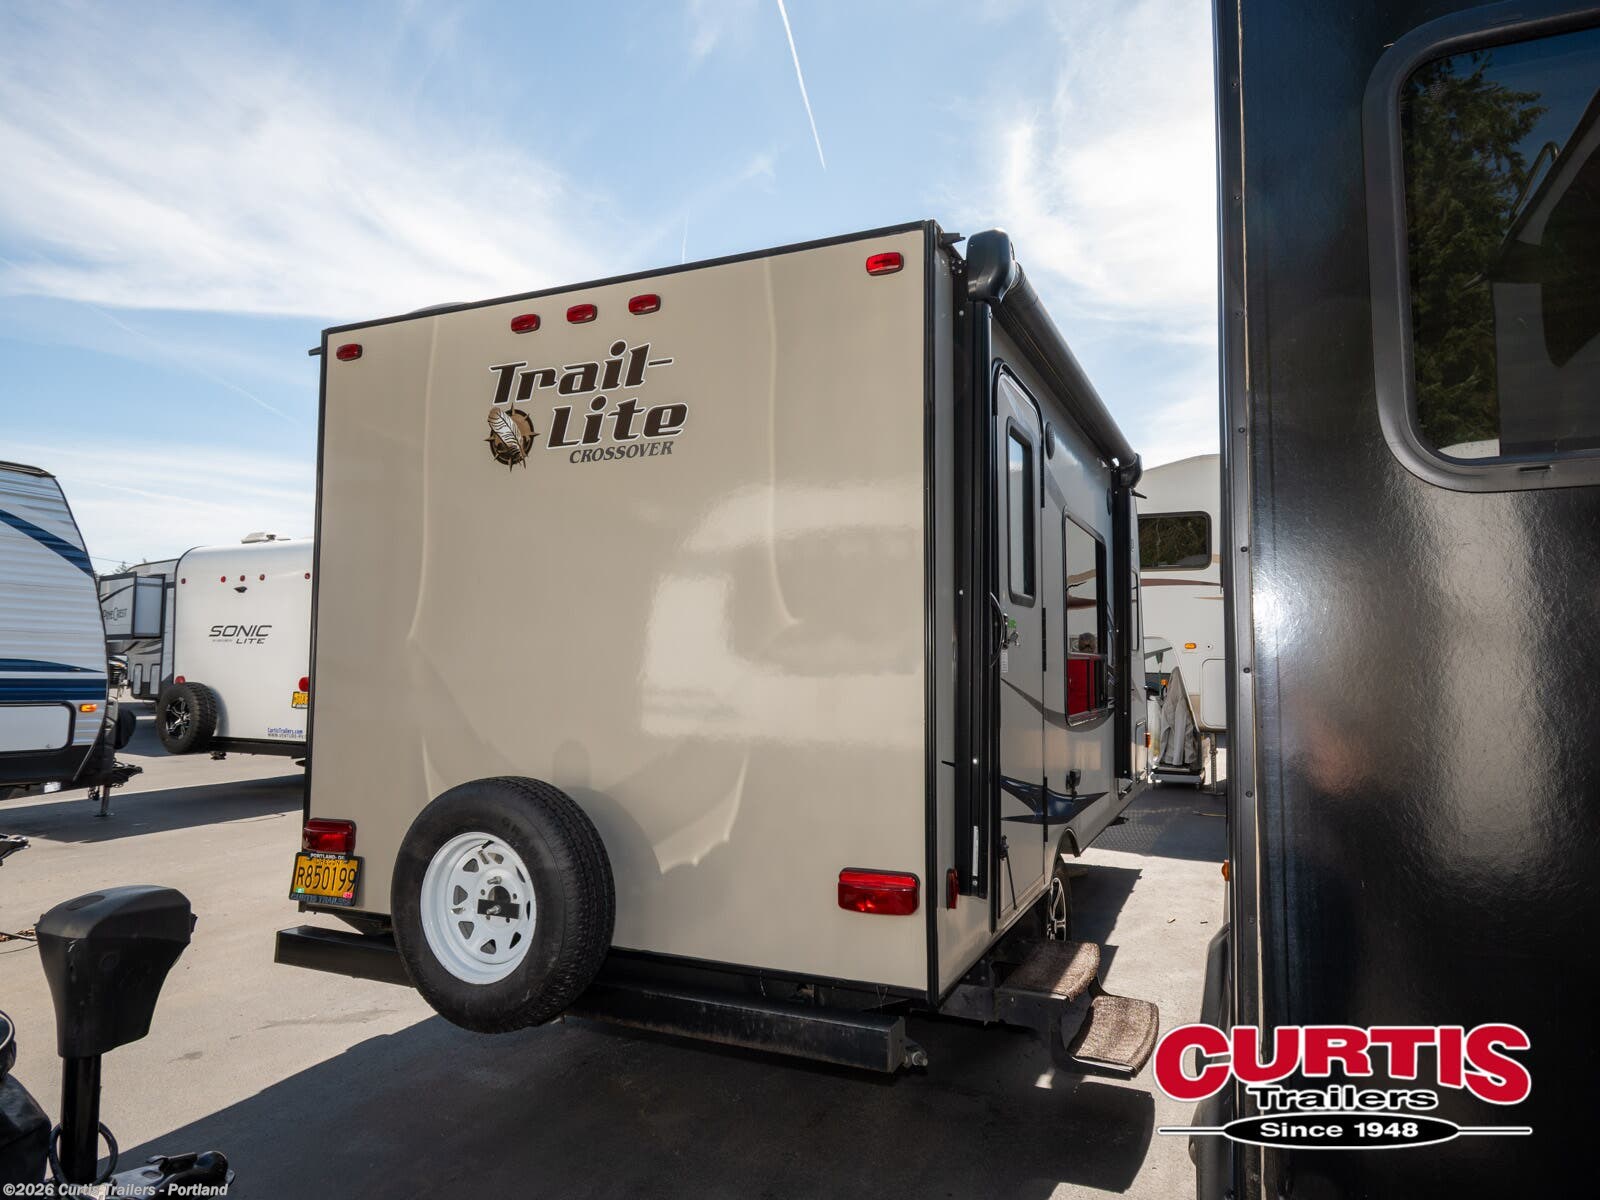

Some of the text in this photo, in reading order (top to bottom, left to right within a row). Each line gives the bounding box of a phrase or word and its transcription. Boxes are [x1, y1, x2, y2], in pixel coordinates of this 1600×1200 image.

[489, 339, 674, 405] Trail-
[546, 394, 688, 449] Lite
[569, 440, 674, 464] CROSSOVER
[208, 624, 273, 637] SONIC
[236, 637, 266, 645] LITE
[295, 863, 357, 893] R850199
